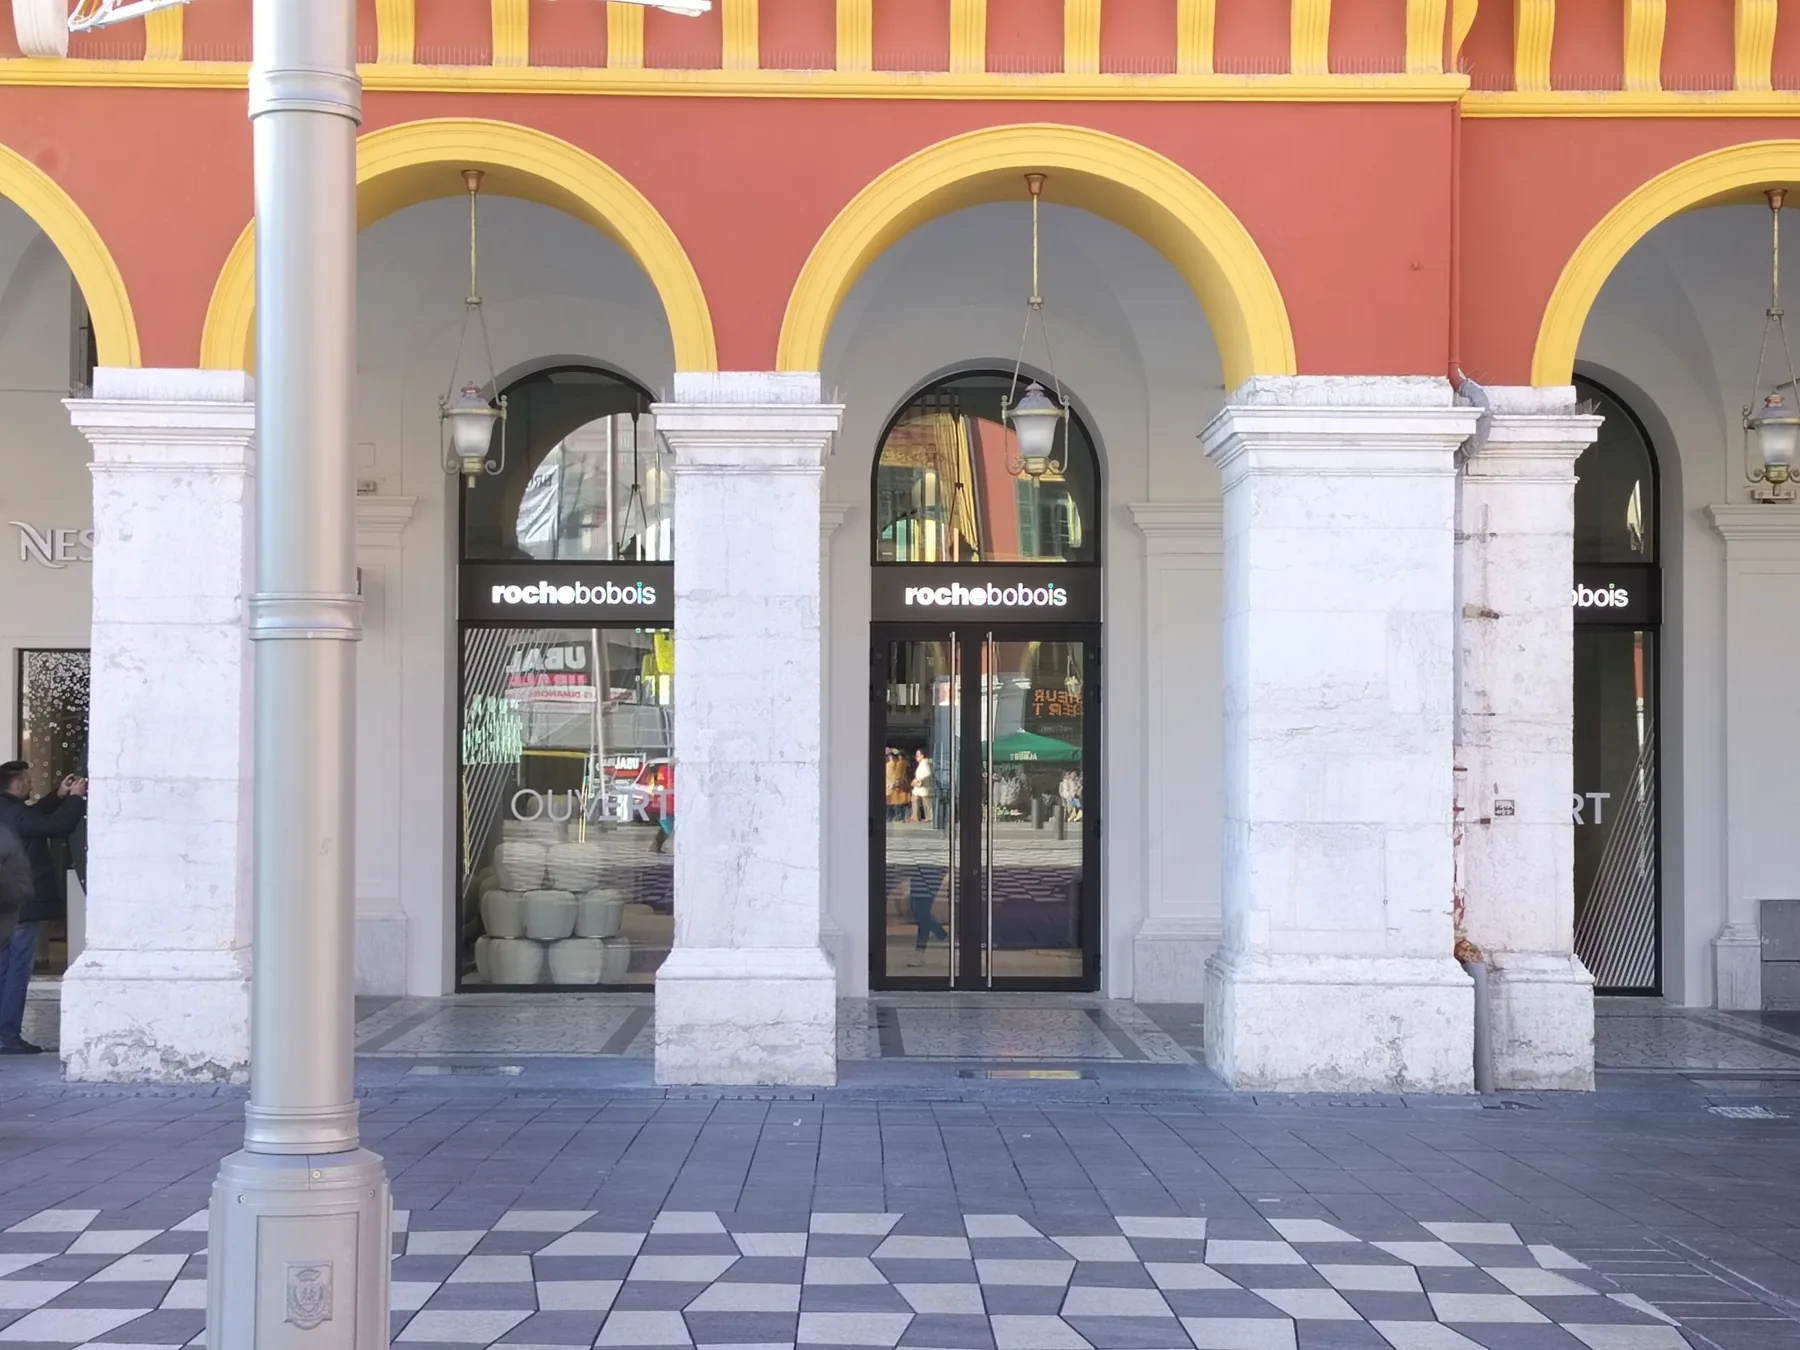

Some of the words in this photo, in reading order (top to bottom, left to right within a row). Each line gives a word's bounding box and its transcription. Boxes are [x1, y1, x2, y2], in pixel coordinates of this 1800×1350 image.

[492, 581, 655, 604] rochebobois
[905, 583, 1067, 606] rochebobois
[511, 788, 674, 822] OUVERT
